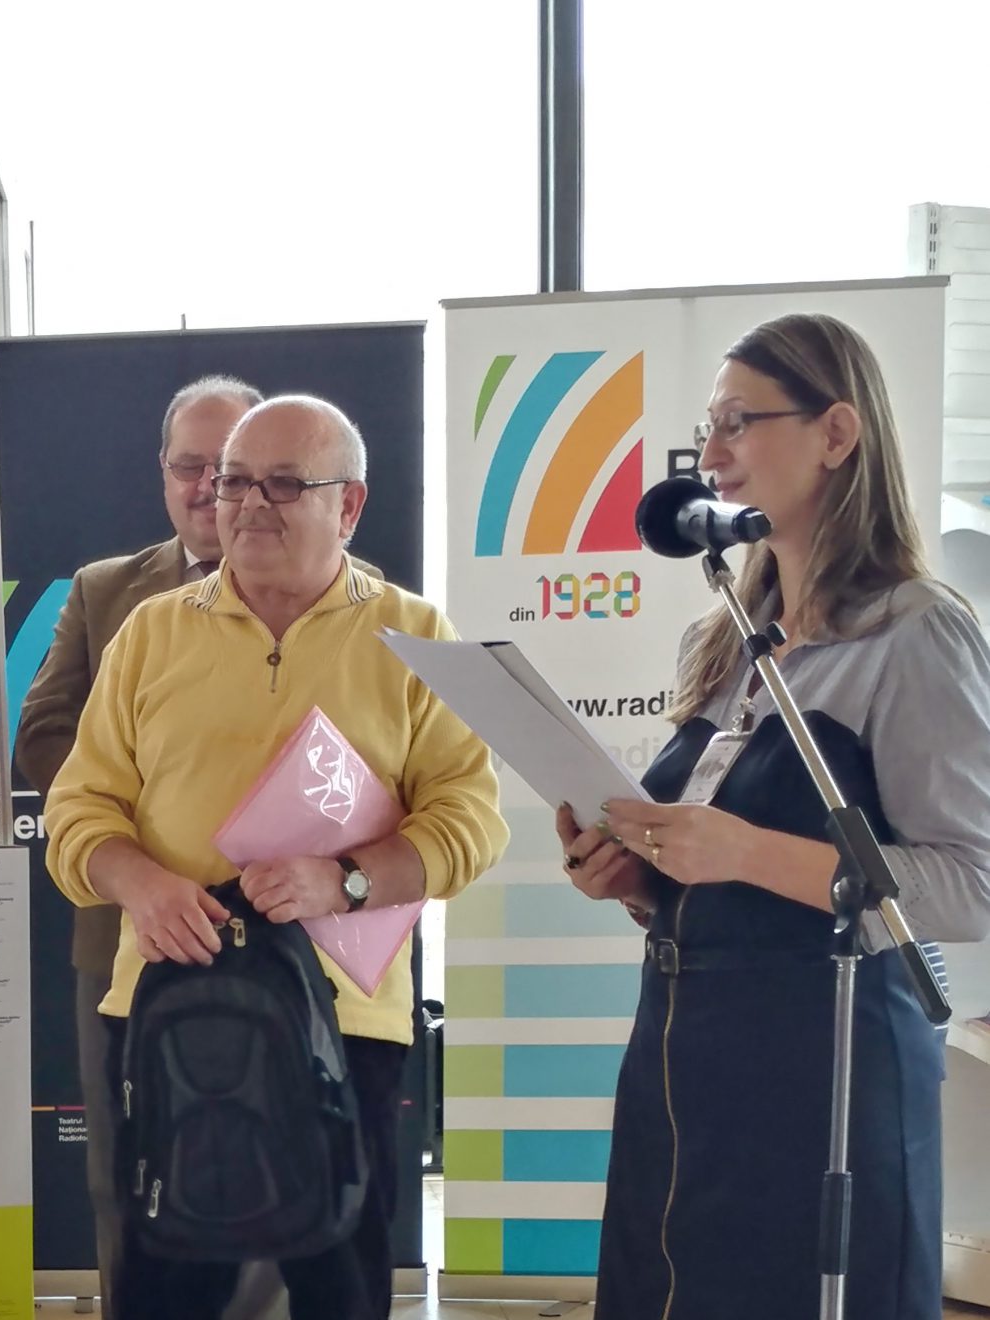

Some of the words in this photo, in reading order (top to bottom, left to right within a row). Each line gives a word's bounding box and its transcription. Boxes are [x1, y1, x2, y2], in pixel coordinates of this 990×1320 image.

[509, 607, 535, 622] din
[536, 571, 641, 620] 1928
[58, 1134, 89, 1142] Radiofo
